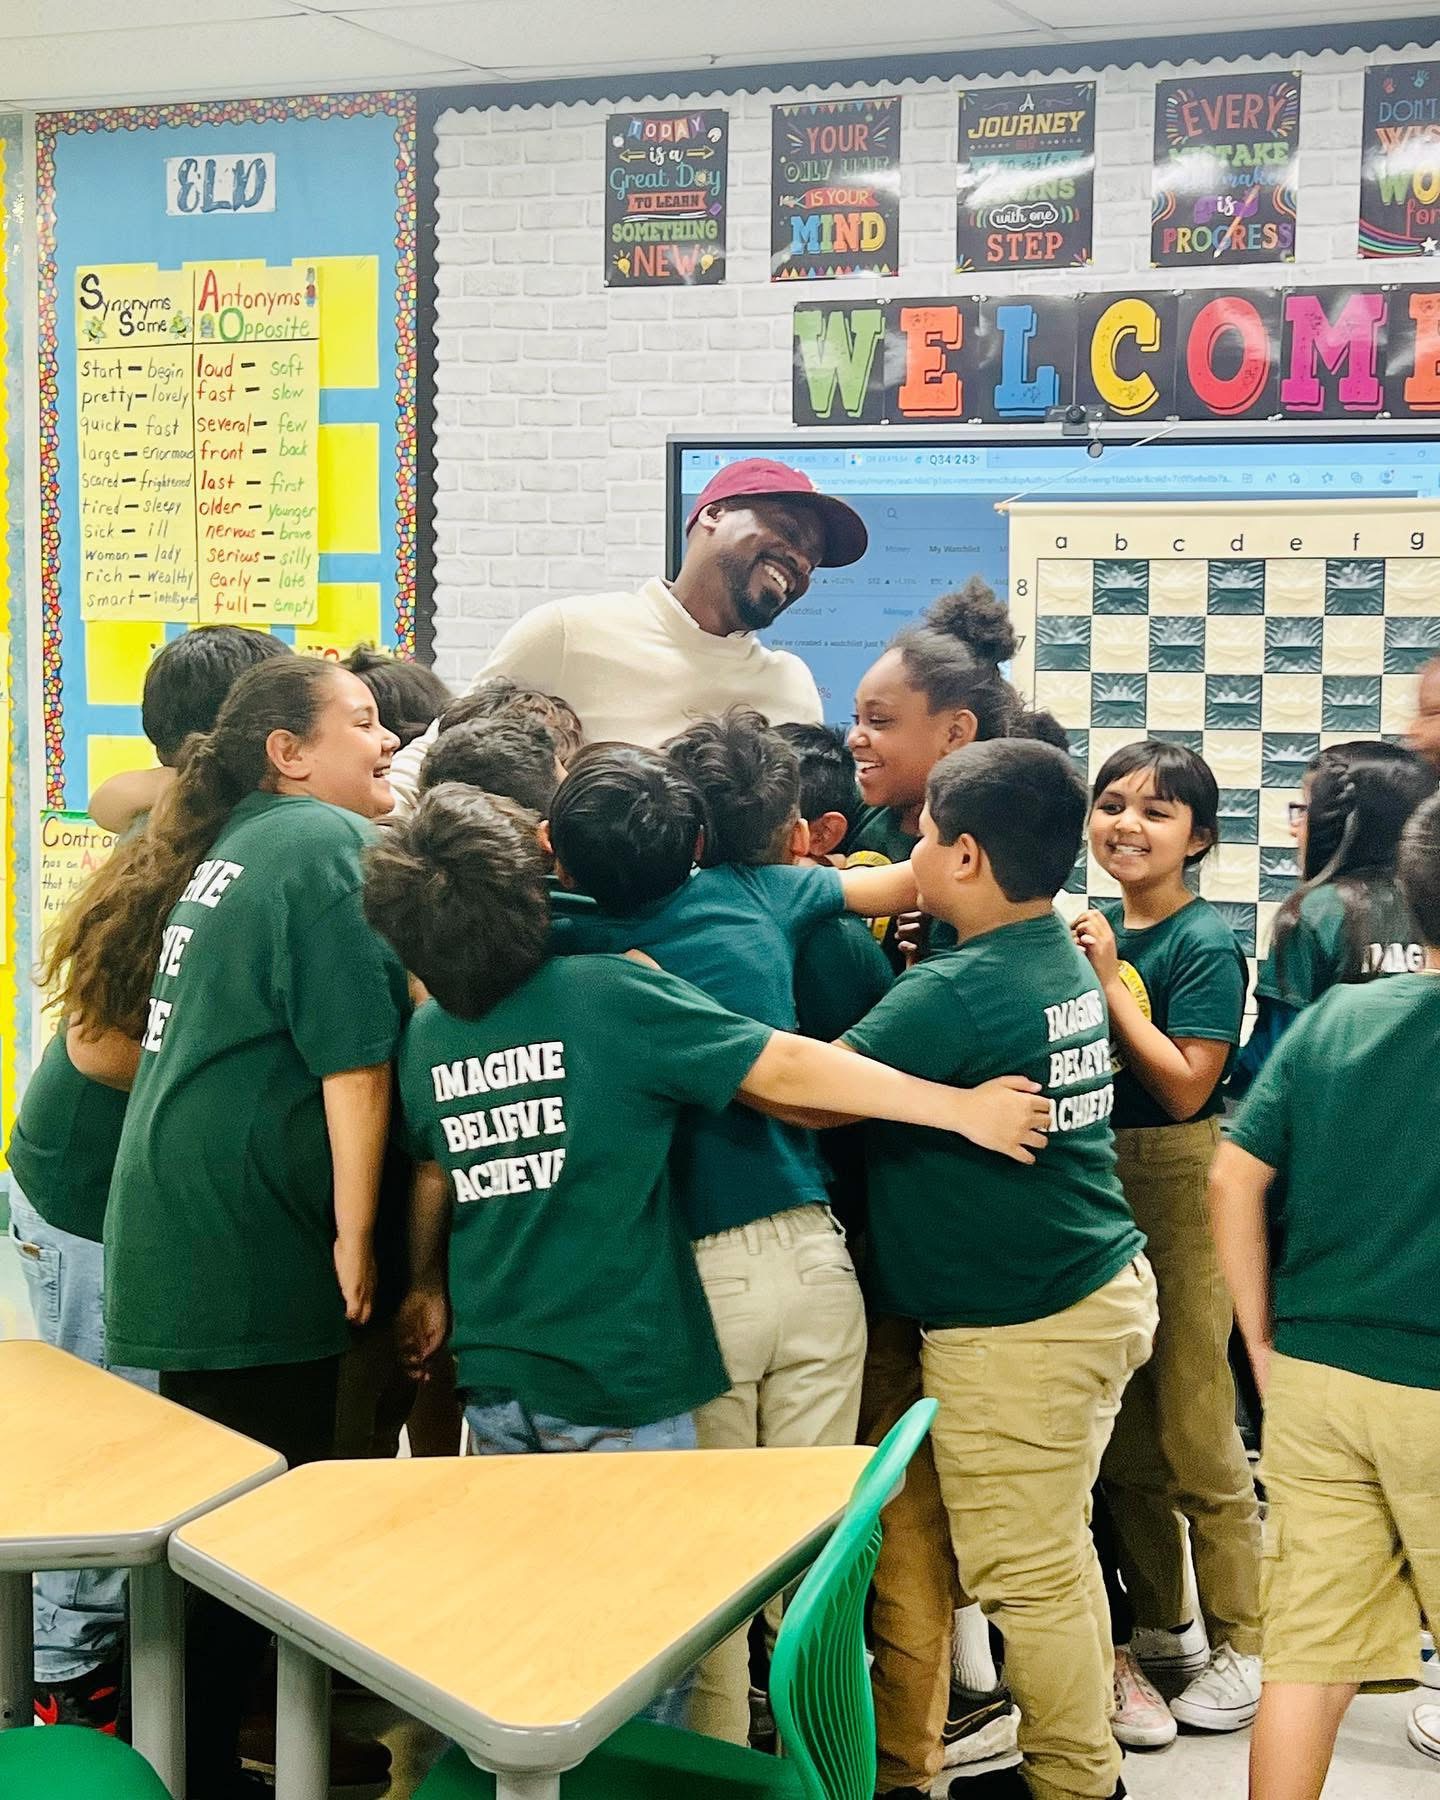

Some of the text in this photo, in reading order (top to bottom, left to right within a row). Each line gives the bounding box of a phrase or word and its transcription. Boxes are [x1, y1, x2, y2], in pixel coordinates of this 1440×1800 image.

[1019, 93, 1035, 112] A
[1378, 98, 1438, 122] DON'T
[967, 111, 1086, 140] JOURNEY
[1181, 93, 1287, 137] EVERY
[631, 117, 702, 138] TODAY
[806, 124, 869, 154] YOUR
[649, 147, 683, 166] is a
[175, 157, 267, 213] ELD
[609, 167, 669, 200] Great
[634, 195, 699, 209] TO LEARN
[811, 189, 869, 206] IS YOUR
[1216, 194, 1238, 217] is
[996, 207, 1054, 224] with one
[612, 220, 718, 242] SOMETHING
[790, 211, 887, 255] MIND
[986, 231, 1064, 262] STEP
[633, 244, 701, 278] NEW
[80, 273, 171, 320] Synonyms
[198, 269, 301, 315] Antonyms
[219, 307, 311, 342] Opposite
[148, 357, 184, 384] begin
[197, 353, 305, 378] loud soft
[82, 384, 189, 411] pretty lovely
[197, 379, 305, 402] fast slow
[80, 415, 179, 437] quick fast
[197, 412, 307, 435] several few
[82, 442, 121, 466] large
[200, 437, 308, 460] front back
[201, 470, 305, 494] last first
[82, 497, 120, 515] tired
[199, 498, 316, 524] older younger
[148, 519, 169, 537] ill
[280, 523, 312, 540] brave
[1055, 531, 1424, 552] a b c d e f g
[154, 544, 182, 564] lady
[280, 549, 312, 569] silly
[86, 569, 123, 583] rich
[210, 571, 305, 589] early late
[1016, 579, 1028, 597] 8
[214, 593, 315, 617] full empty
[1016, 635, 1027, 651] 7
[431, 1041, 566, 1102] IMAGINE
[440, 1096, 566, 1153] BELIEVE
